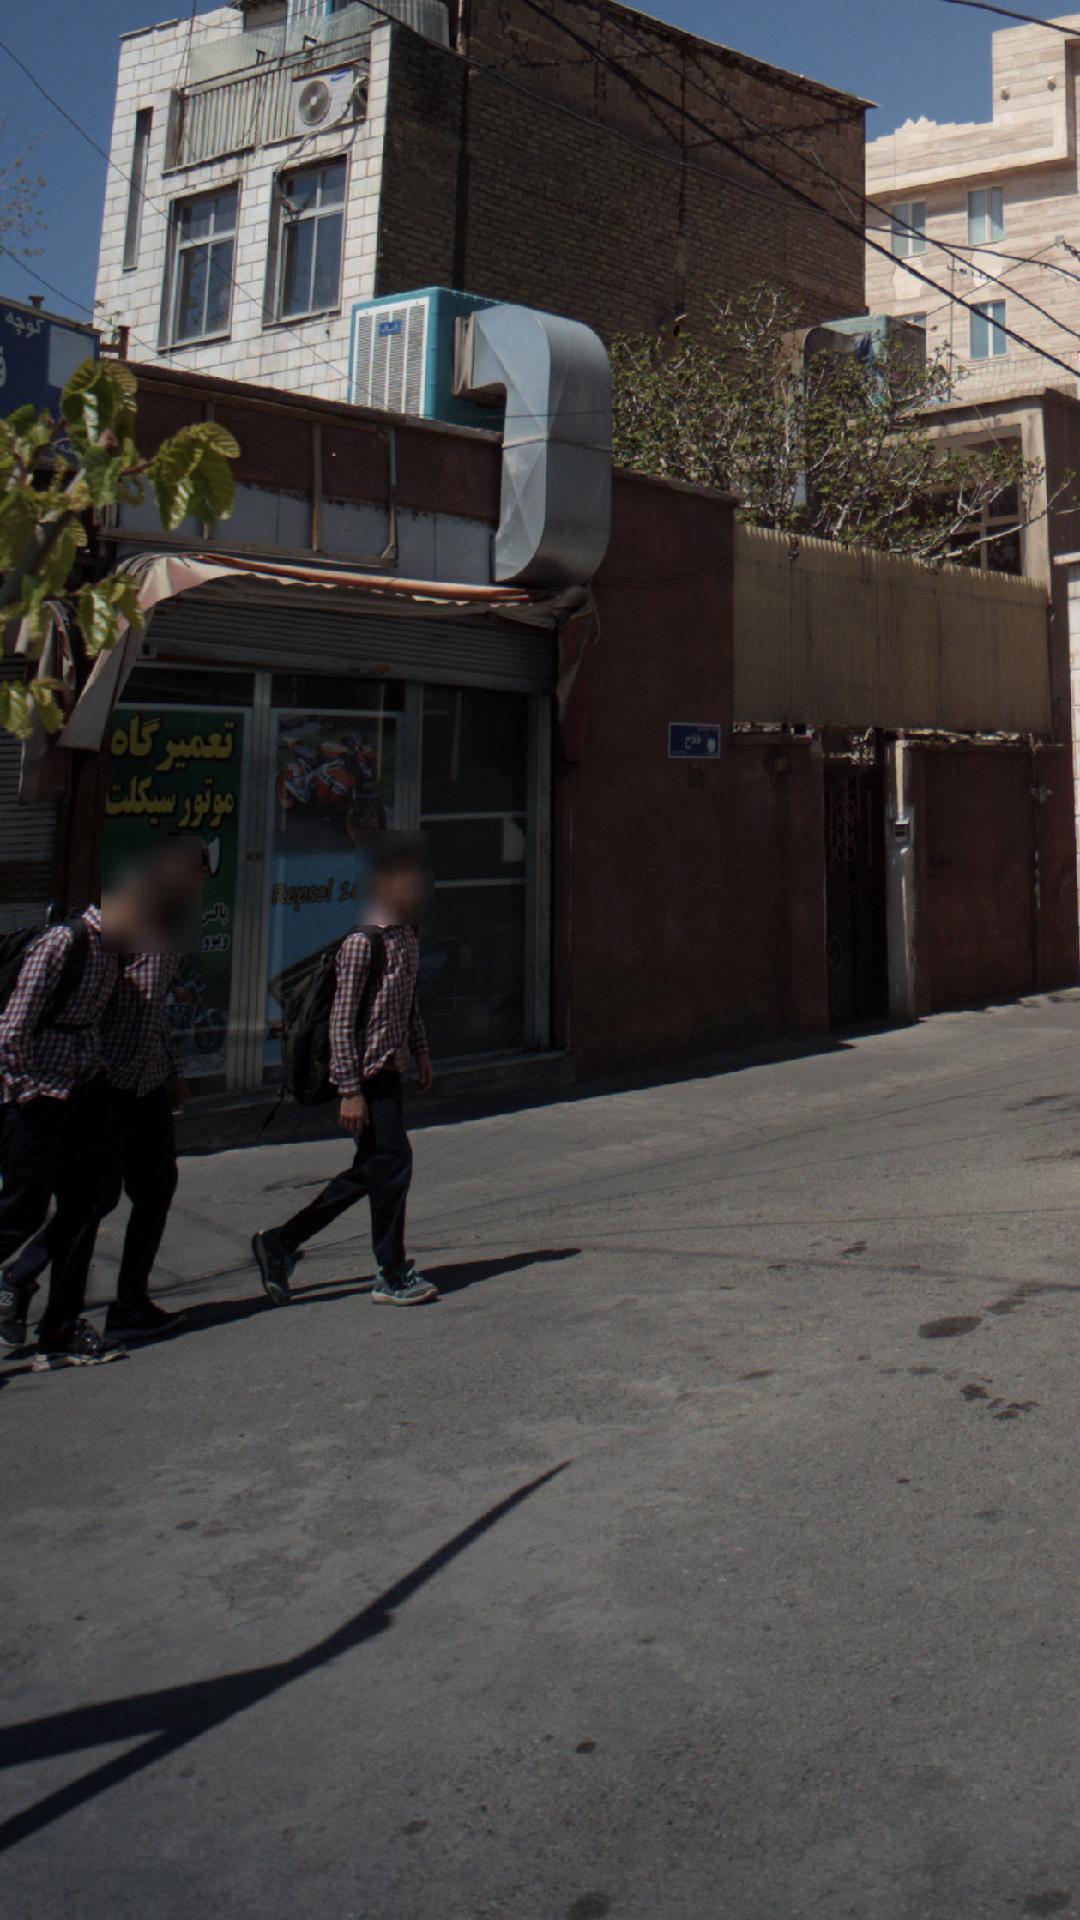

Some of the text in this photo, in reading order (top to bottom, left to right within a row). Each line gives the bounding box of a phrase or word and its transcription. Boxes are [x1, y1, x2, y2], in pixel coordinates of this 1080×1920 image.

[5, 311, 45, 338] کوچه
[111, 715, 234, 771] تعمیر گاه
[105, 776, 234, 828] موتور سیکلت
[272, 877, 334, 911] Repsol
